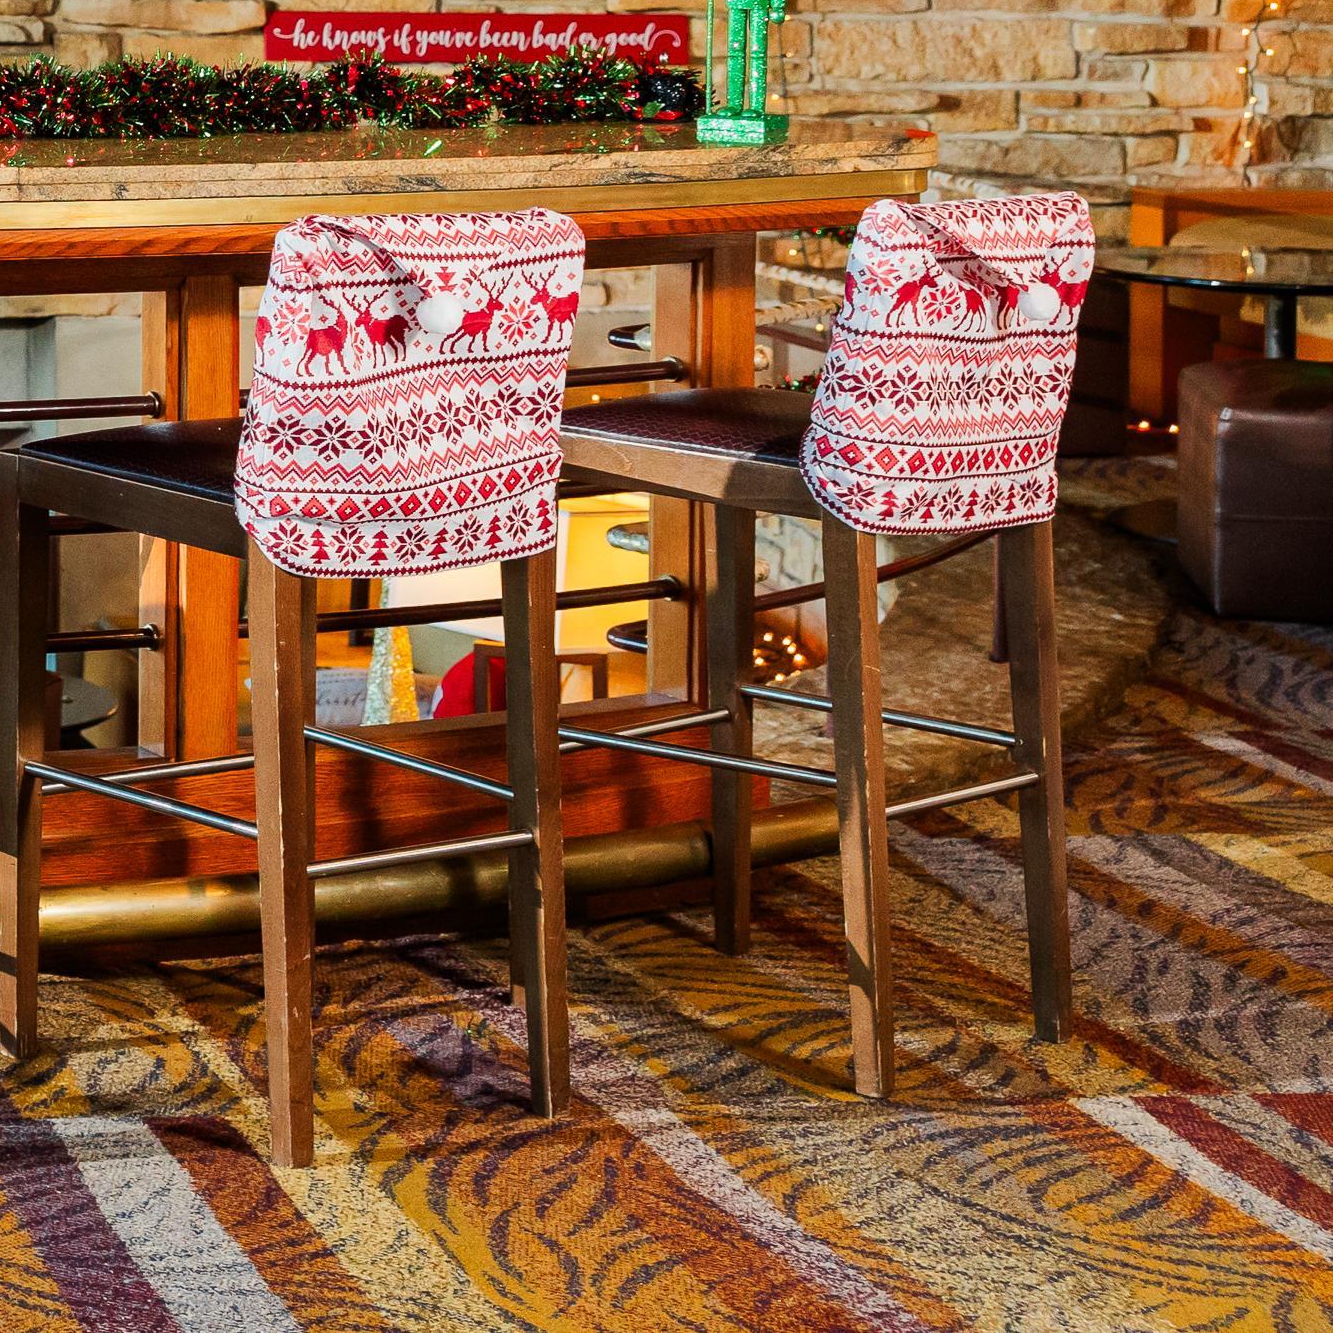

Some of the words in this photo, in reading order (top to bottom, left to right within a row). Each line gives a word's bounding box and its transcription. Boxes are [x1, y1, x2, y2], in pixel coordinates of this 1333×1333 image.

[273, 17, 321, 50] he
[321, 21, 391, 54] knows
[392, 22, 414, 55] if
[415, 27, 478, 57] you've
[479, 19, 532, 52] been
[532, 19, 579, 52] bad
[604, 22, 682, 57] good
